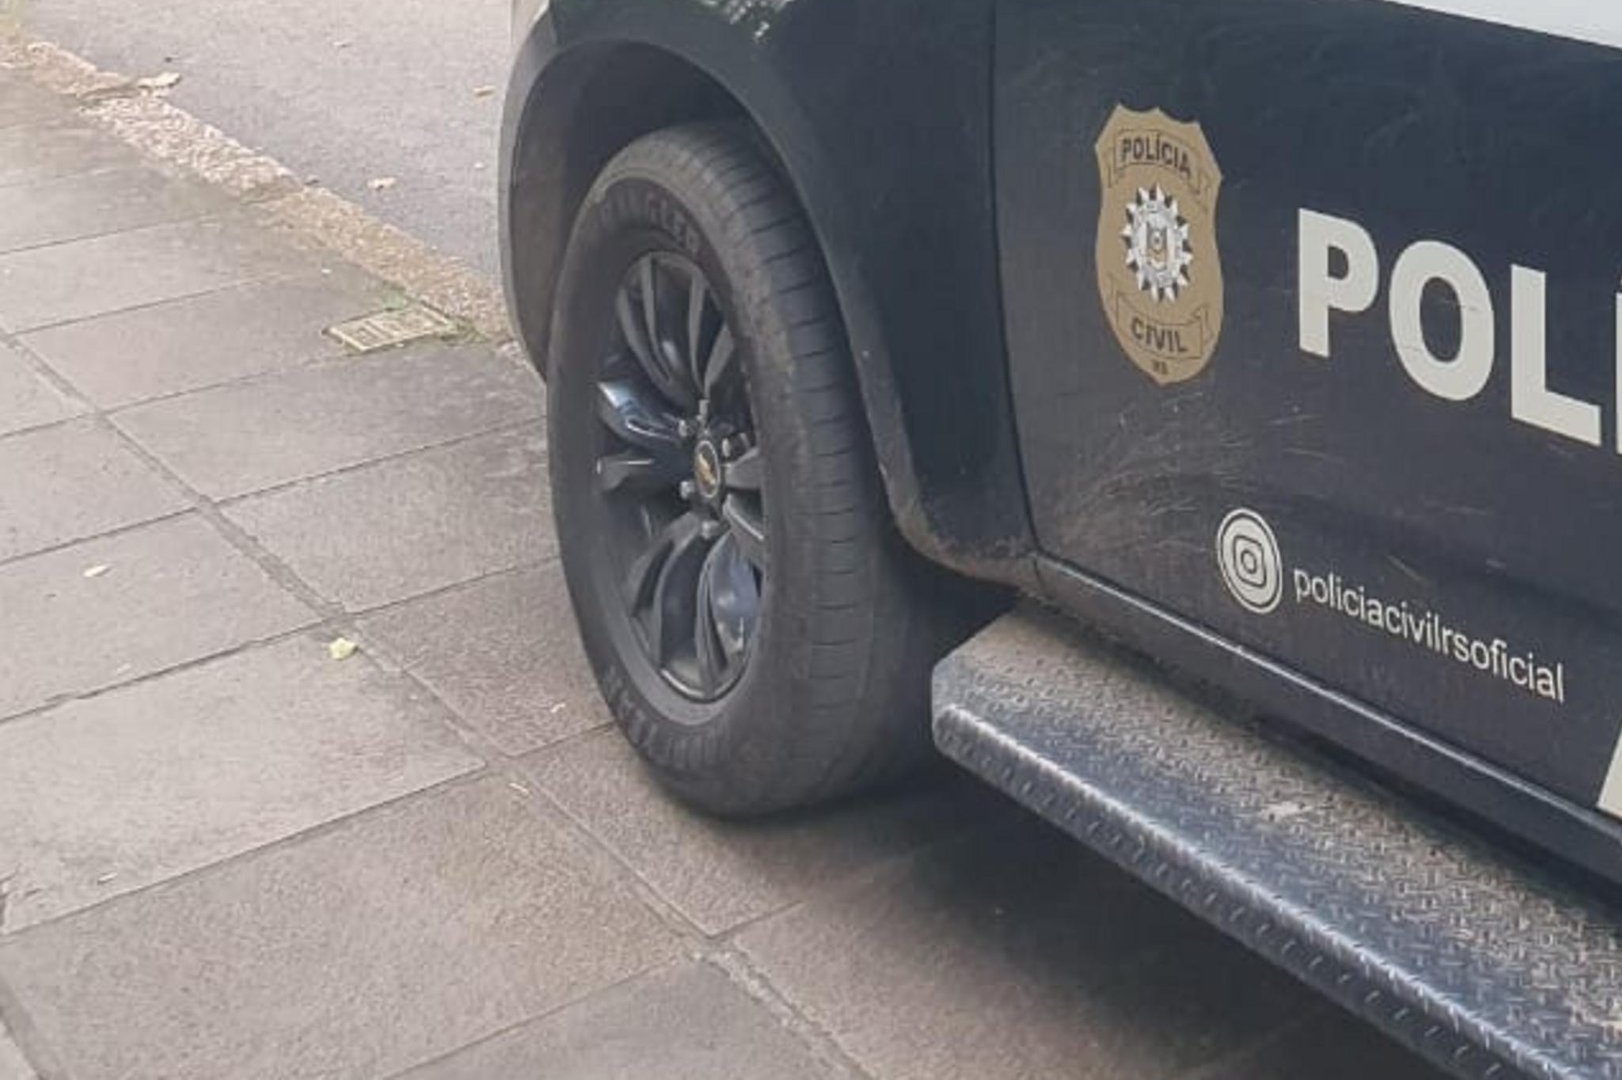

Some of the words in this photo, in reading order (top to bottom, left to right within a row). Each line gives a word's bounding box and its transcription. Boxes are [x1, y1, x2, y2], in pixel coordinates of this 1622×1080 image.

[1121, 137, 1191, 177] POLÍCIA
[1131, 317, 1187, 353] CIVIL
[1293, 567, 1564, 704] policiacivilrsoficial
